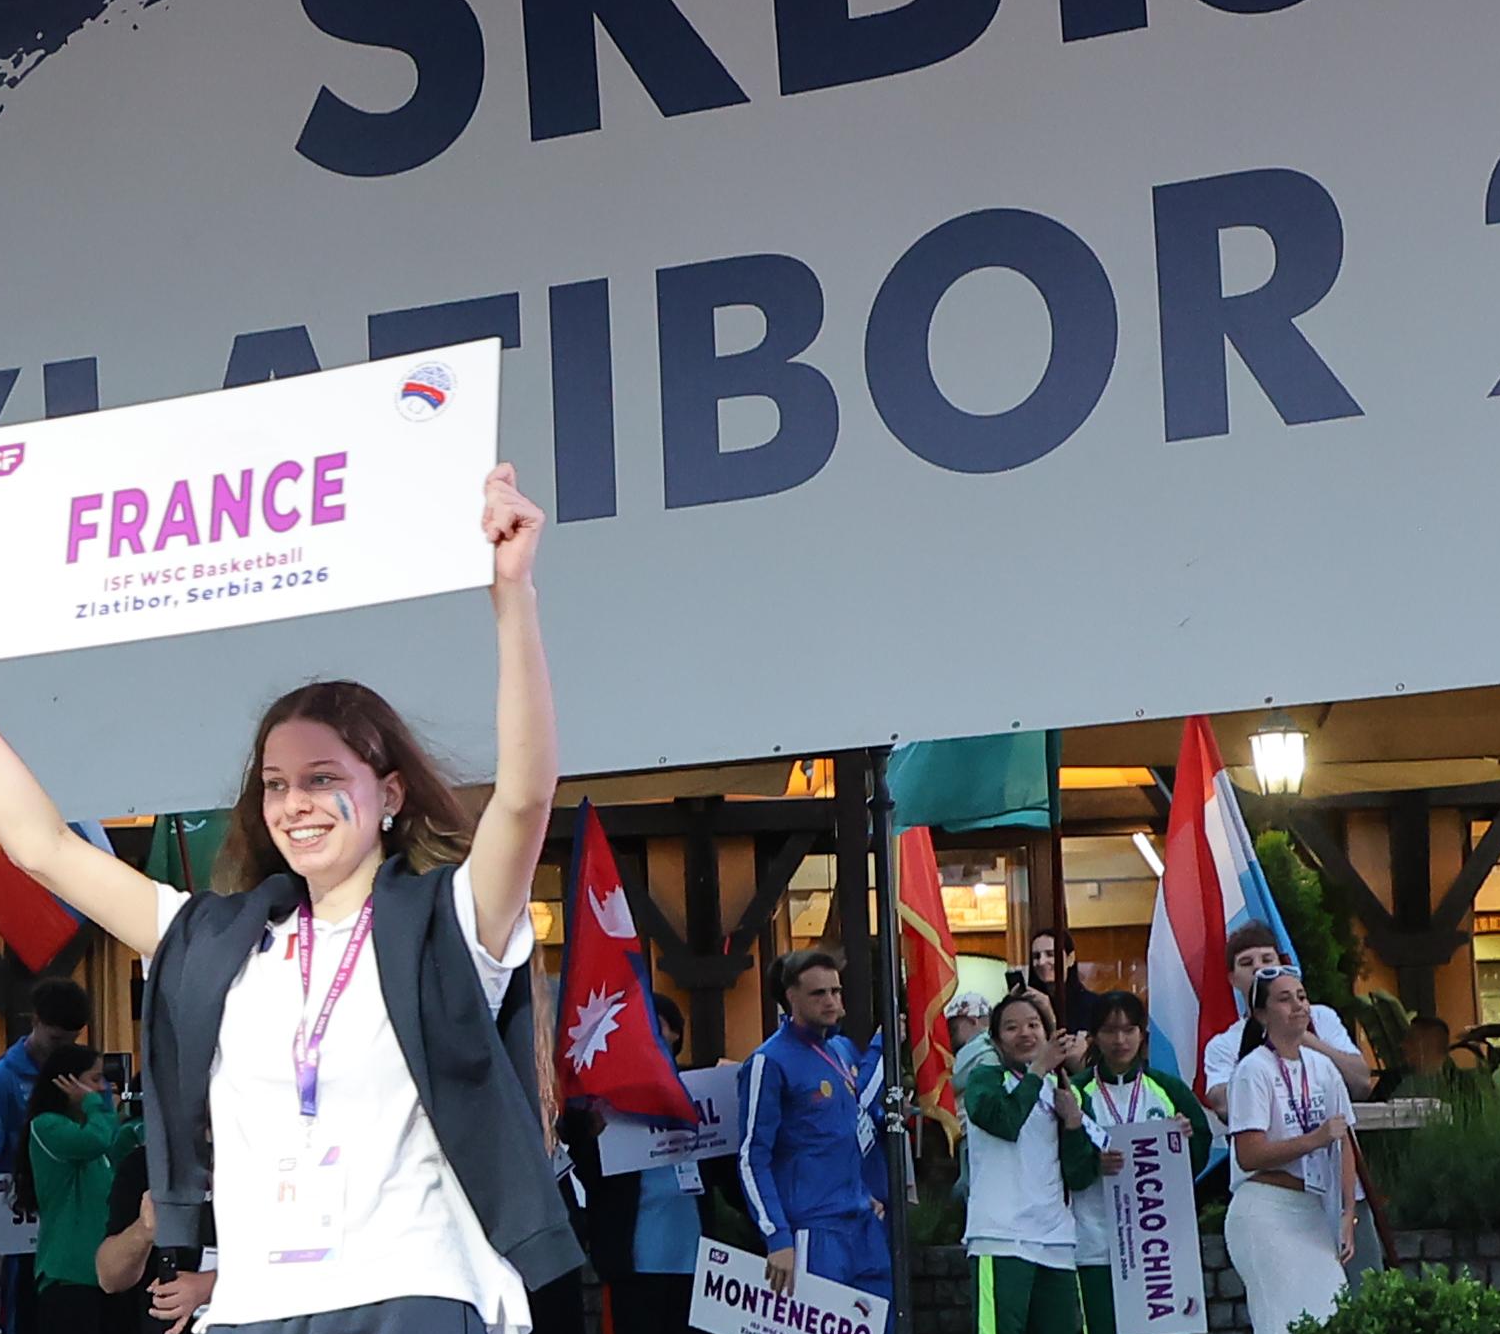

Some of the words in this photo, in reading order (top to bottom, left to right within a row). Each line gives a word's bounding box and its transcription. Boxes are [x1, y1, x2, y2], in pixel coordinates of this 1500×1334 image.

[65, 451, 349, 565] FRANCE
[75, 593, 180, 619] Zlatibor,
[186, 579, 264, 603] Serbia
[272, 567, 330, 590] 2026
[103, 574, 134, 592] ISF
[140, 566, 187, 588] WSC
[192, 546, 304, 580] Basketball
[1131, 1137, 1167, 1232] MACAO
[1141, 1238, 1175, 1321] CHINA
